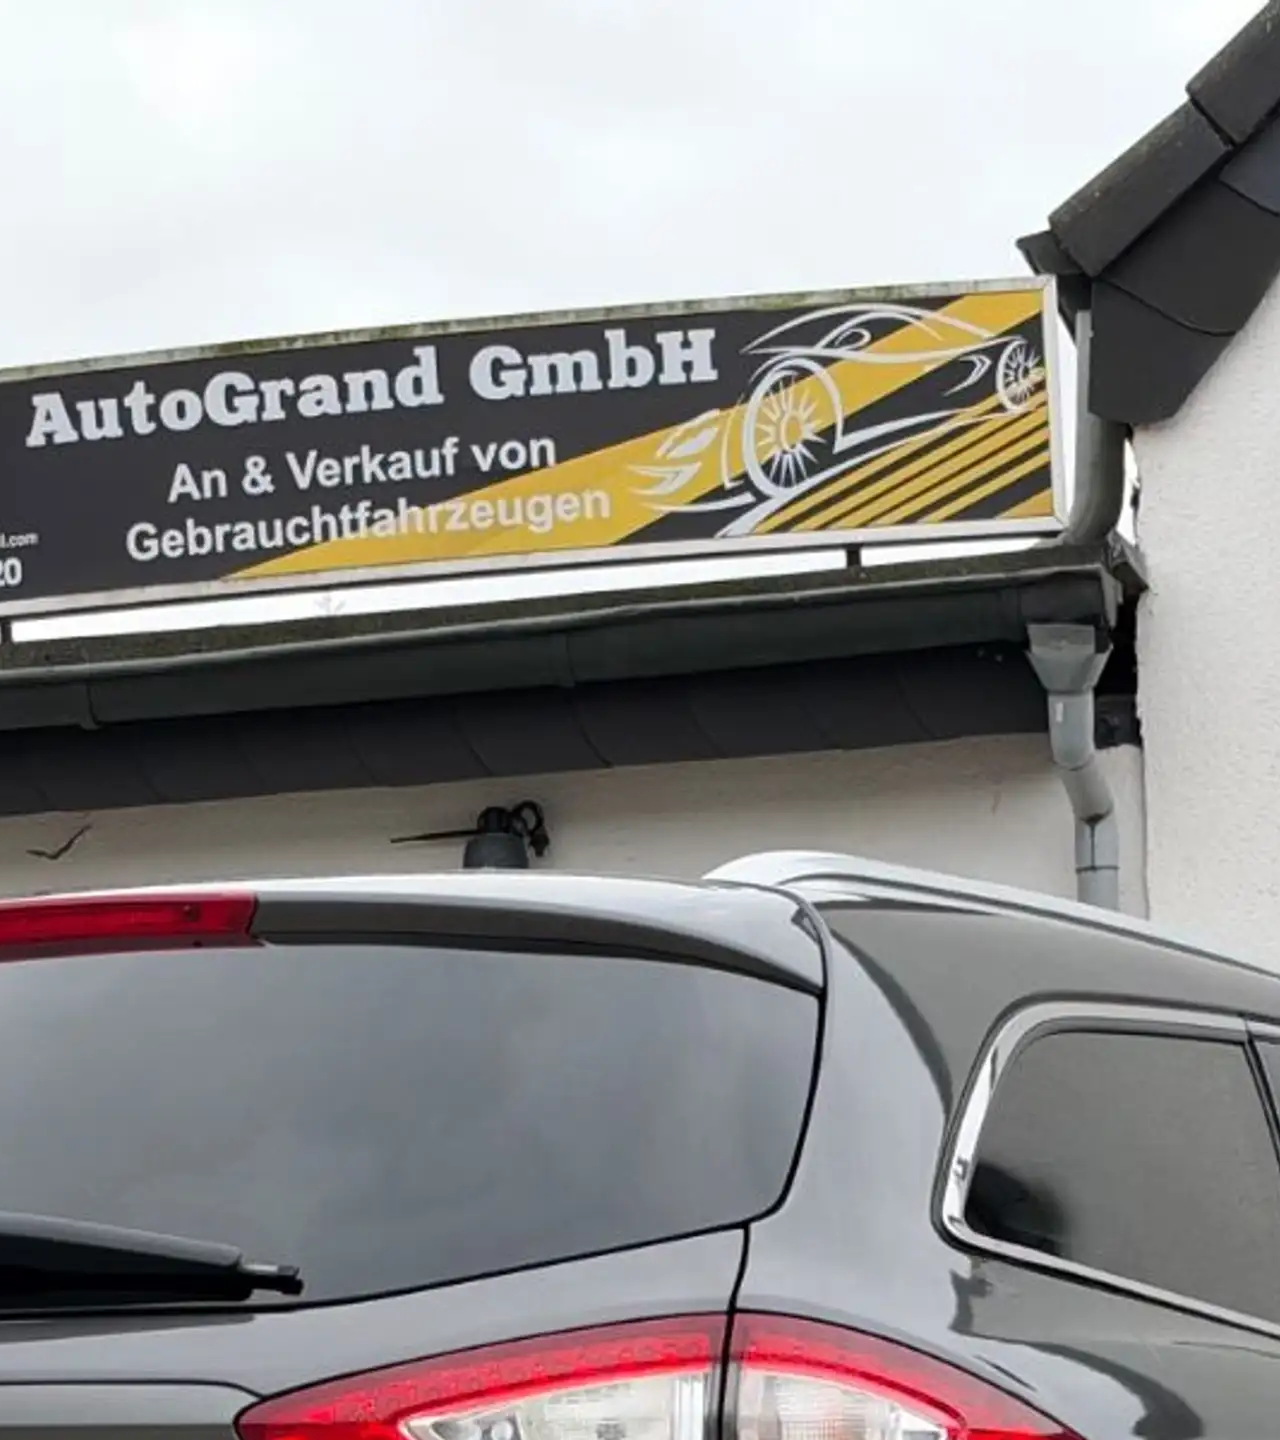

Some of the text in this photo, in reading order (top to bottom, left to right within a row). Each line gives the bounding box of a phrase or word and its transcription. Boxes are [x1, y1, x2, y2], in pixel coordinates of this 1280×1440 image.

[25, 328, 719, 447] AutoGrand GmbH
[167, 436, 556, 503] An & Verkauf von
[125, 486, 611, 562] Gebrauchtfahrzeugen
